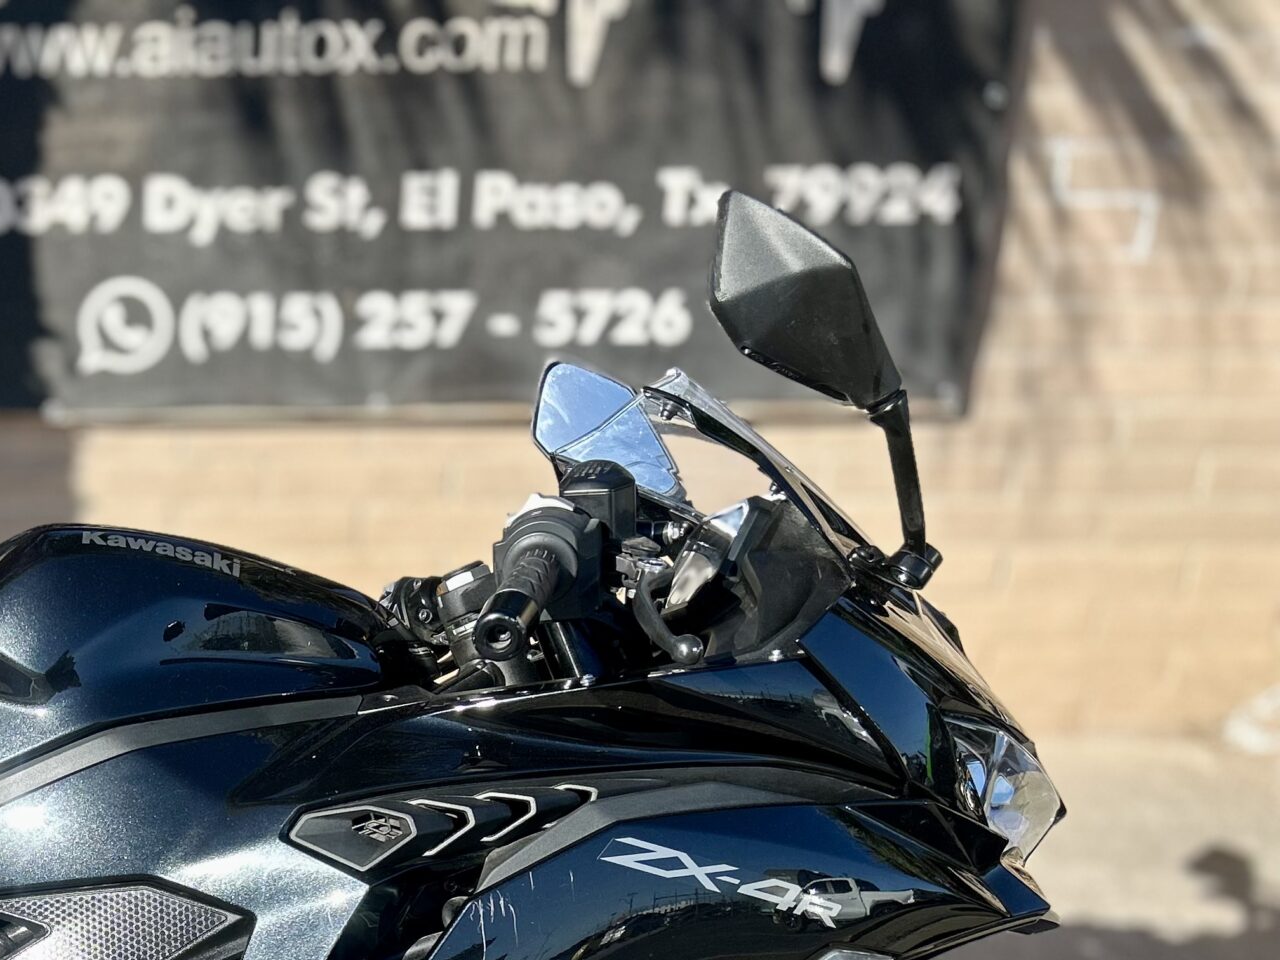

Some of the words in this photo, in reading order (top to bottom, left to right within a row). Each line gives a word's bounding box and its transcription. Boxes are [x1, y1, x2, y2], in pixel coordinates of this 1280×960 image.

[142, 172, 294, 247] Dyer
[303, 170, 388, 240] St,
[400, 168, 461, 230] El
[473, 168, 642, 237] Paso,
[763, 163, 964, 226] 79924
[178, 290, 344, 366] (915)
[354, 289, 477, 351] 257
[486, 308, 519, 339] -
[532, 288, 694, 348] 5726
[82, 530, 241, 578] Kawasaki
